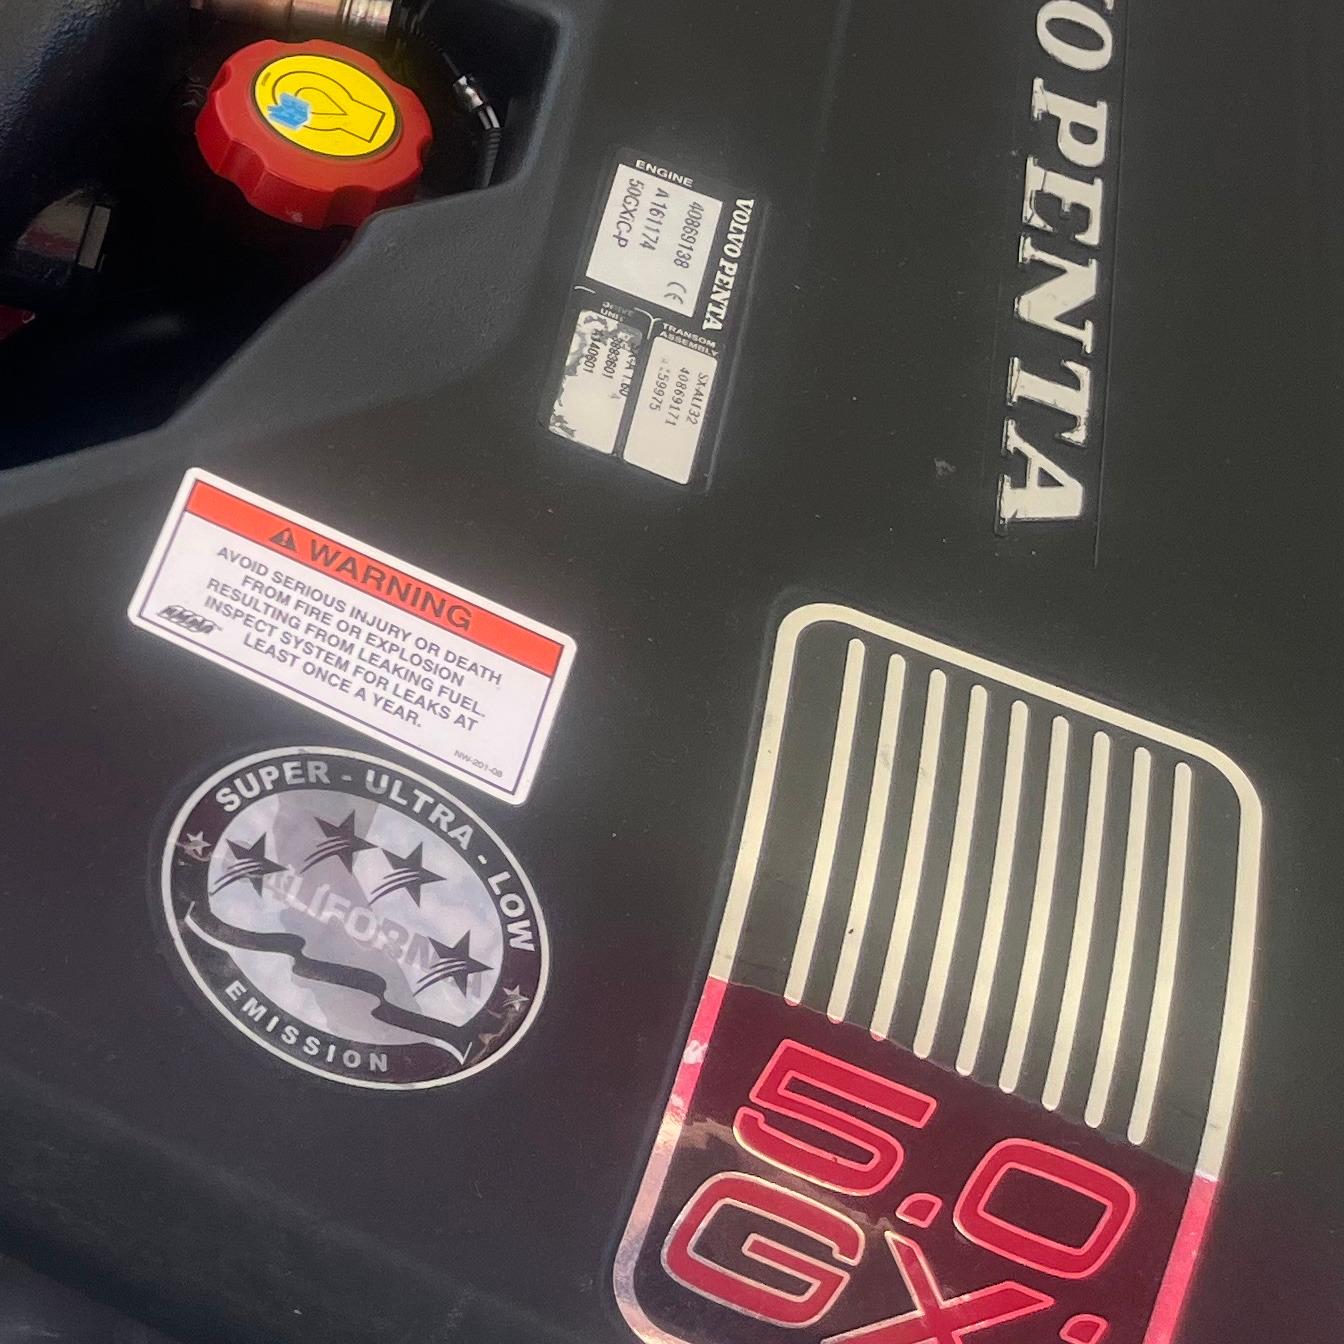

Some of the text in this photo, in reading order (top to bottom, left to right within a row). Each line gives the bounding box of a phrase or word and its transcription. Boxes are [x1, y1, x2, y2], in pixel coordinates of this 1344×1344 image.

[635, 159, 694, 188] ENGINE
[640, 201, 669, 251] 161174
[673, 201, 705, 269] 40869138
[702, 197, 755, 331] VOLVO PENTA
[995, 76, 1110, 529] PENTA
[662, 322, 717, 349] TRANSOM
[217, 546, 503, 686] AVOID SERIOUS INJURY OR DEATH
[241, 575, 465, 687] FROM FIRE OR EXPLOSION
[310, 538, 474, 632] WARNING
[204, 595, 479, 732] INSPECT SYSTEM FOR LEAKS AT
[206, 577, 486, 718] RESULTING FROM LEAKING FUEL.
[243, 632, 422, 728] LEAST ONCE A YEAR.
[214, 760, 331, 814] SUPER
[364, 768, 475, 852] ULTRA
[487, 870, 536, 953] LOW
[224, 979, 389, 1074] EMISSION
[732, 1038, 1137, 1280] 5.0
[660, 1171, 1109, 1344] GX
